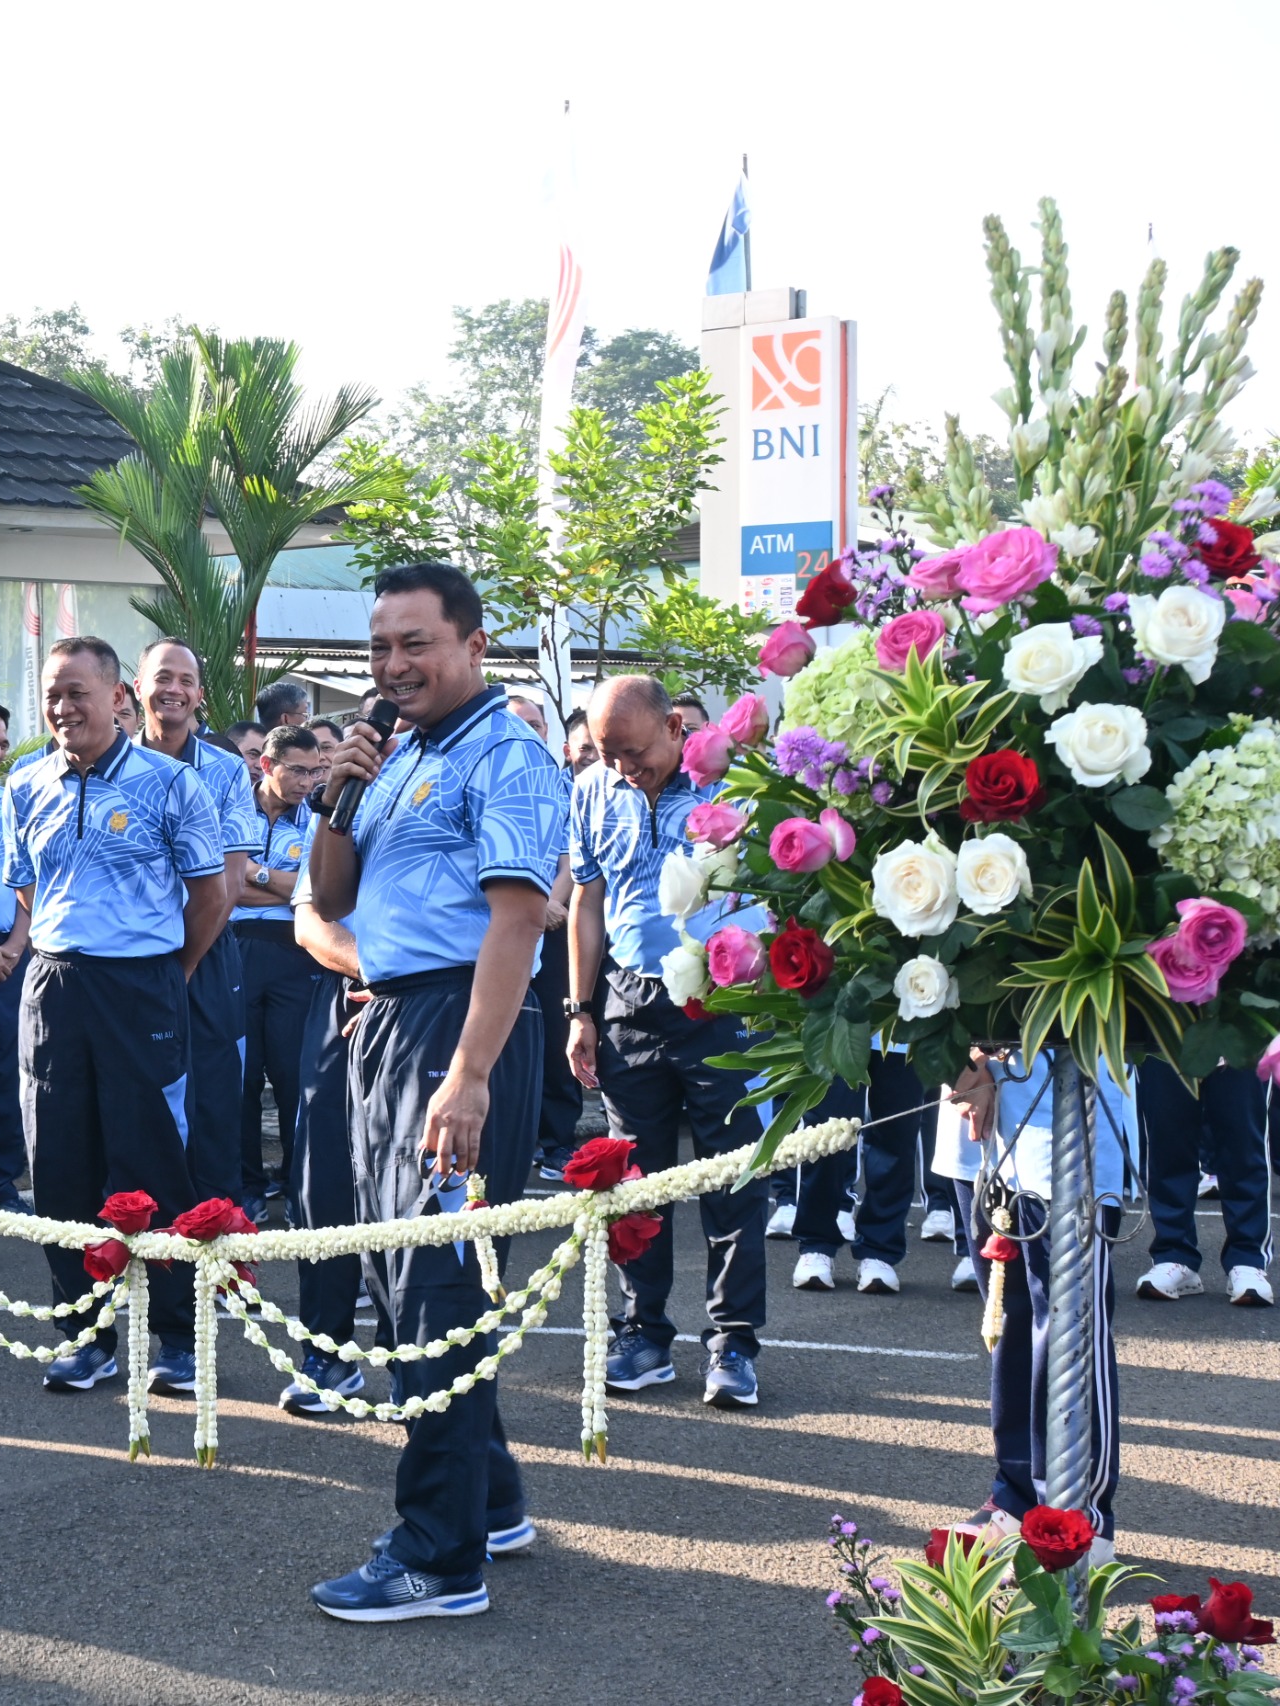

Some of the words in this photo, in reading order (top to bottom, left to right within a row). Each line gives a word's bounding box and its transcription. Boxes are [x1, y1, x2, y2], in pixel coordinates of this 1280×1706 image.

[752, 424, 820, 460] BNI
[749, 533, 794, 554] ATM
[797, 551, 829, 578] 24
